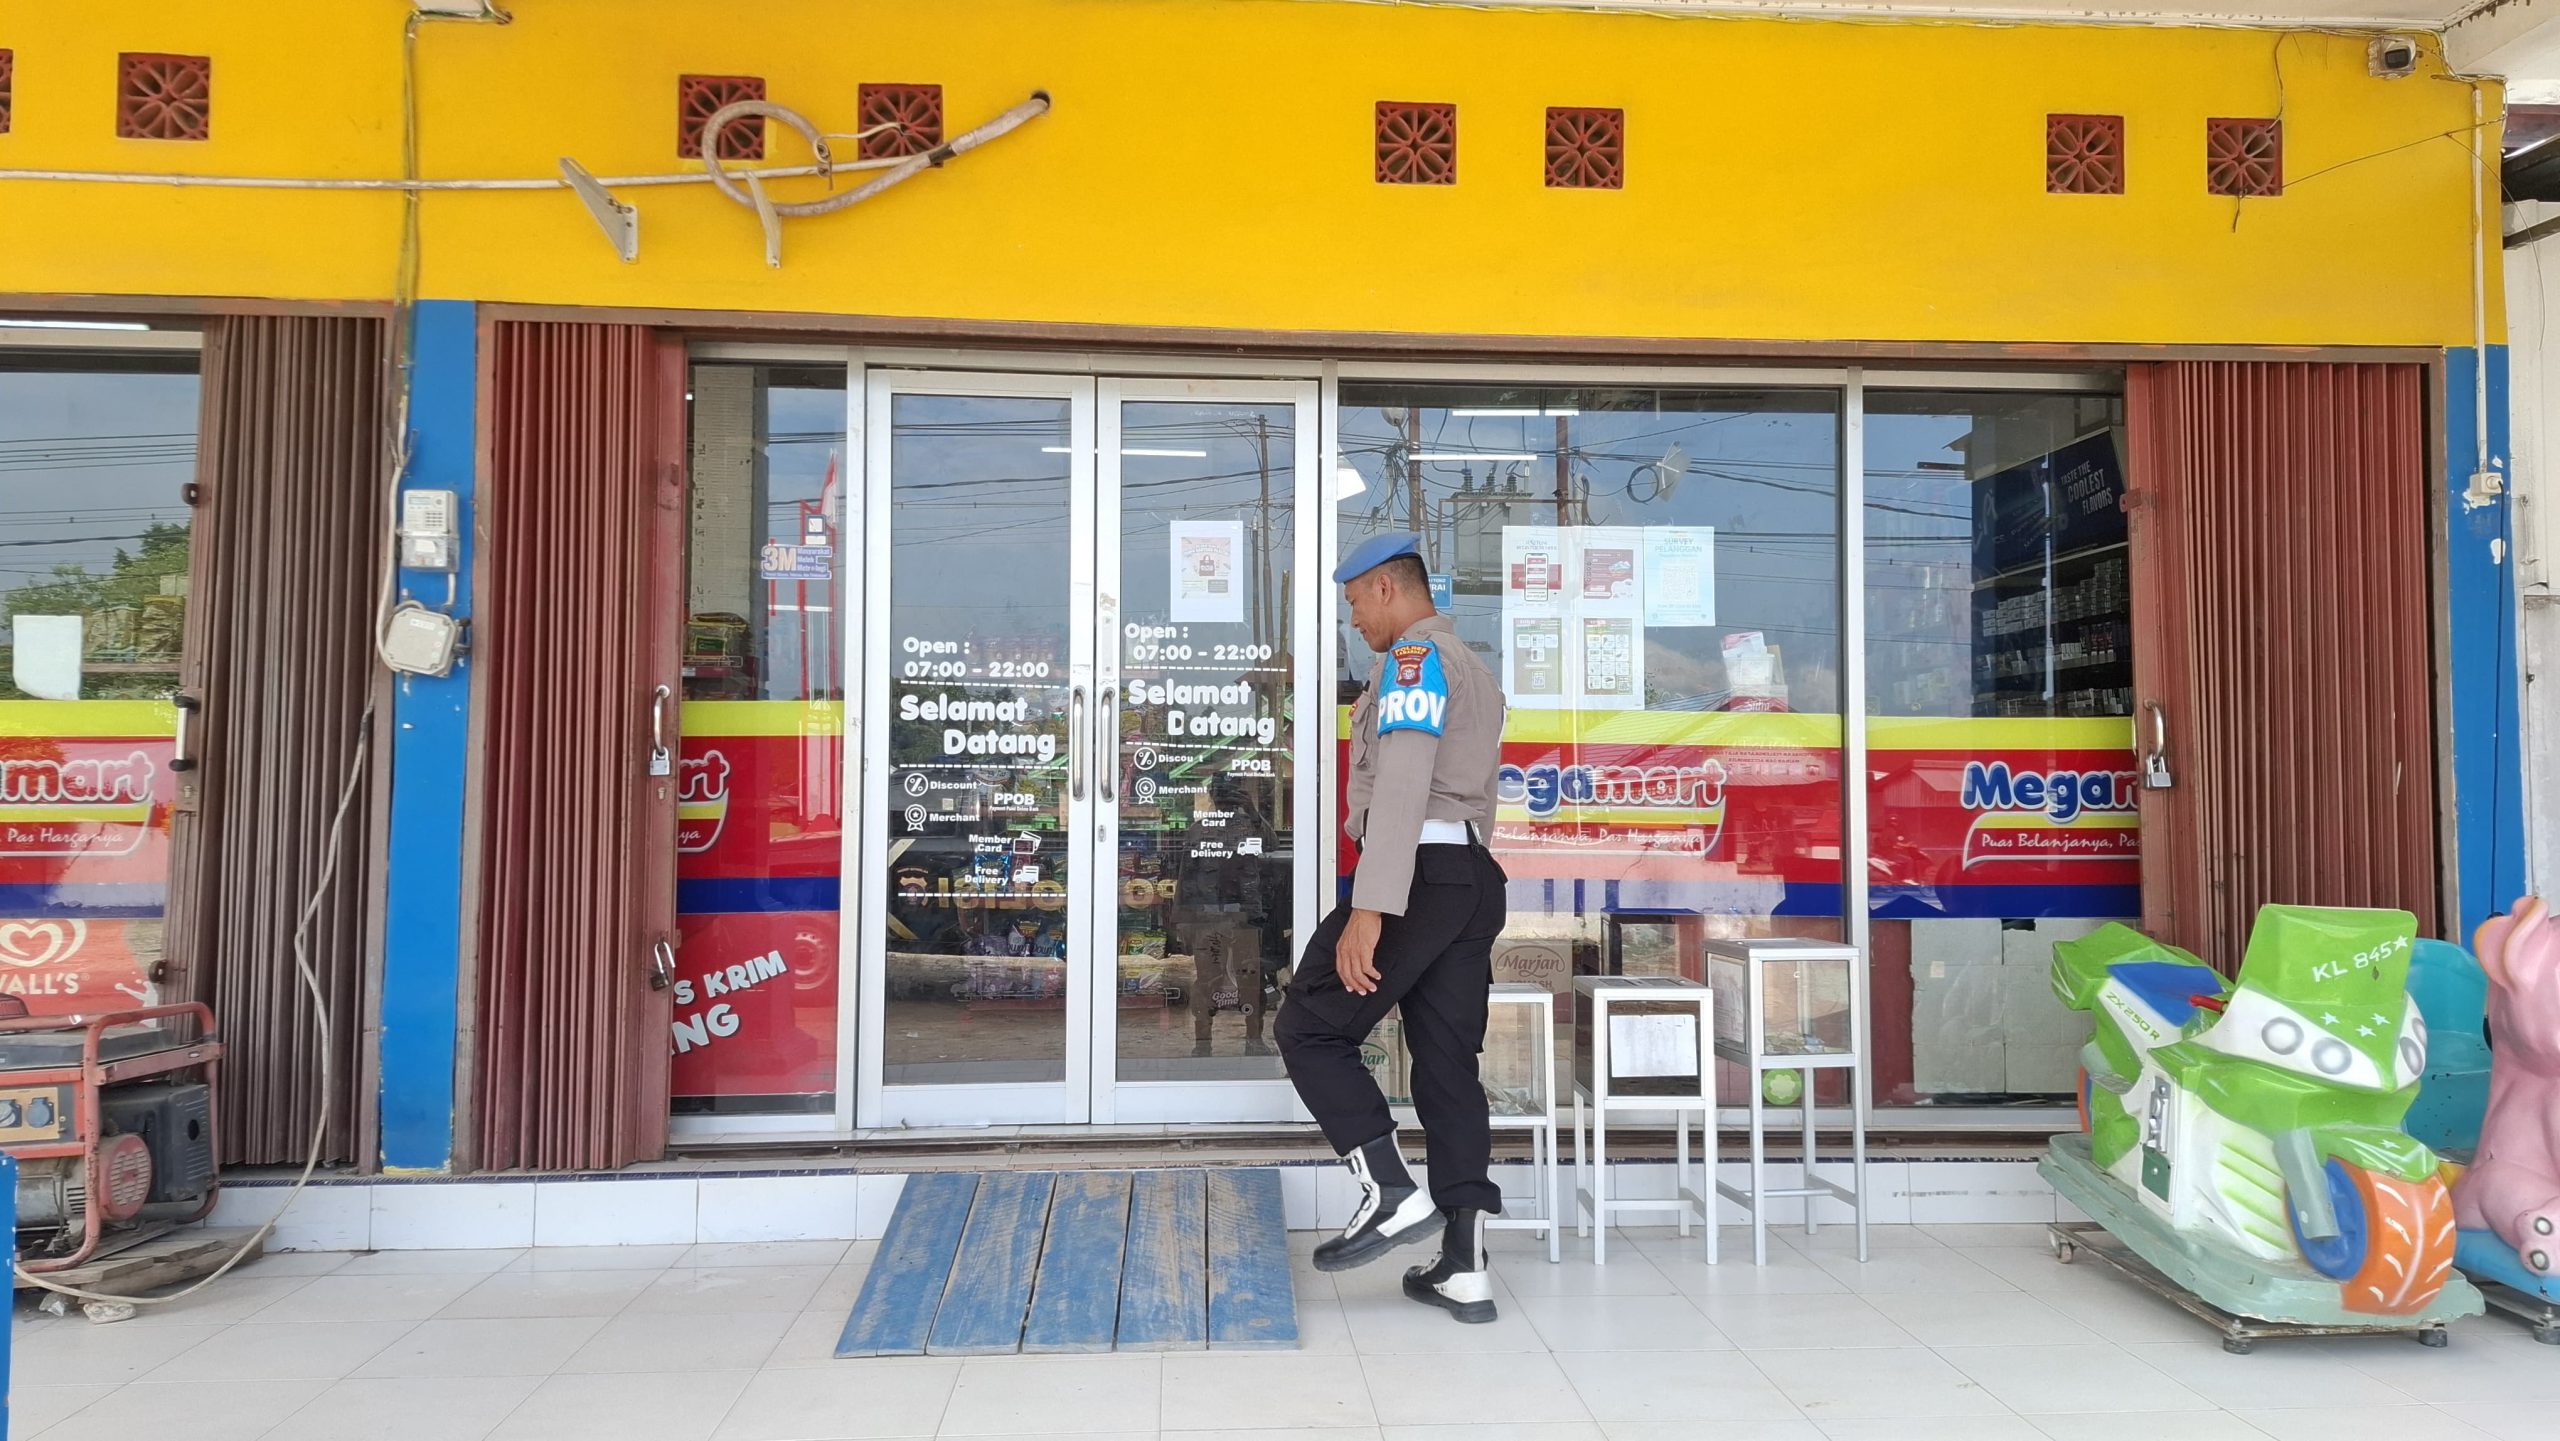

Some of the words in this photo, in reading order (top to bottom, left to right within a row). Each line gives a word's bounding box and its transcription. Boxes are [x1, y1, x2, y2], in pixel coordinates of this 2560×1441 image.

[2078, 460, 2091, 476] THE
[2067, 468, 2104, 503] COOLEST
[2082, 487, 2113, 516] FLAVORS
[764, 546, 797, 571] 3M
[1125, 623, 1177, 643] Open
[903, 637, 958, 658] Open
[1133, 645, 1192, 660] 07:00
[1213, 644, 1272, 660] 22:00
[904, 661, 967, 677] 07:00
[988, 661, 1049, 678] 22:00
[1128, 678, 1252, 705] Selamat
[900, 692, 1029, 722] Selamat
[1377, 688, 1446, 732] PROV
[943, 729, 1056, 762] Datang
[1158, 755, 1204, 763] Discout
[1231, 759, 1272, 771] PPOB
[930, 781, 977, 790] Discount
[1159, 786, 1207, 794] Merchant
[1497, 758, 1728, 817] egamart
[994, 793, 1035, 805] PPOB
[929, 813, 980, 822] Merchant
[1193, 810, 1234, 818] Member
[1201, 819, 1226, 827] Card
[8, 828, 34, 843] Pas
[40, 829, 124, 848] Harganya
[968, 834, 1012, 843] Member
[1600, 828, 1622, 843] Pas
[1982, 833, 2013, 847] Puas
[977, 844, 1003, 852] Card
[1200, 841, 1223, 849] Free
[1191, 849, 1233, 859] Delivery
[975, 866, 999, 875] Free
[964, 875, 1009, 886] Delivery
[1503, 953, 1561, 978] Marjan
[2312, 960, 2348, 983] KL
[2353, 942, 2393, 969] 845
[703, 950, 788, 998] KRIM
[1212, 990, 1238, 1001] Good
[1215, 997, 1239, 1008] Time
[2106, 991, 2125, 1010] ZX
[2124, 1006, 2152, 1032] 250
[2149, 1030, 2161, 1041] R
[672, 1003, 740, 1055] NG
